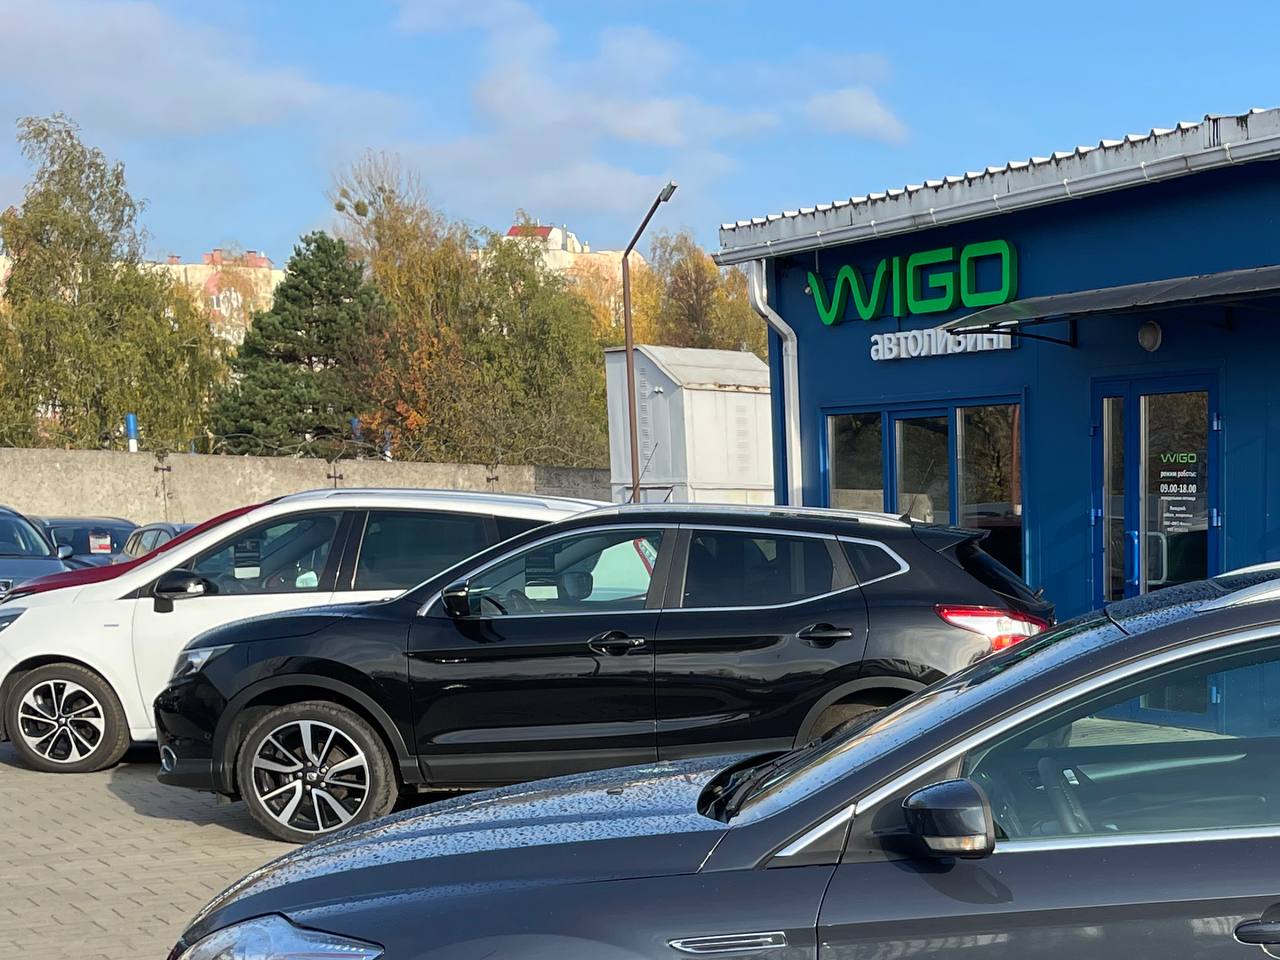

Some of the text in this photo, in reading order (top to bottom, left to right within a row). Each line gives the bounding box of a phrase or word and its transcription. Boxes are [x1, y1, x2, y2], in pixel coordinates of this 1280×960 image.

[807, 239, 1017, 326] WIGO
[1160, 453, 1197, 463] WIGO
[1160, 483, 1197, 493] 09.00-18.00
